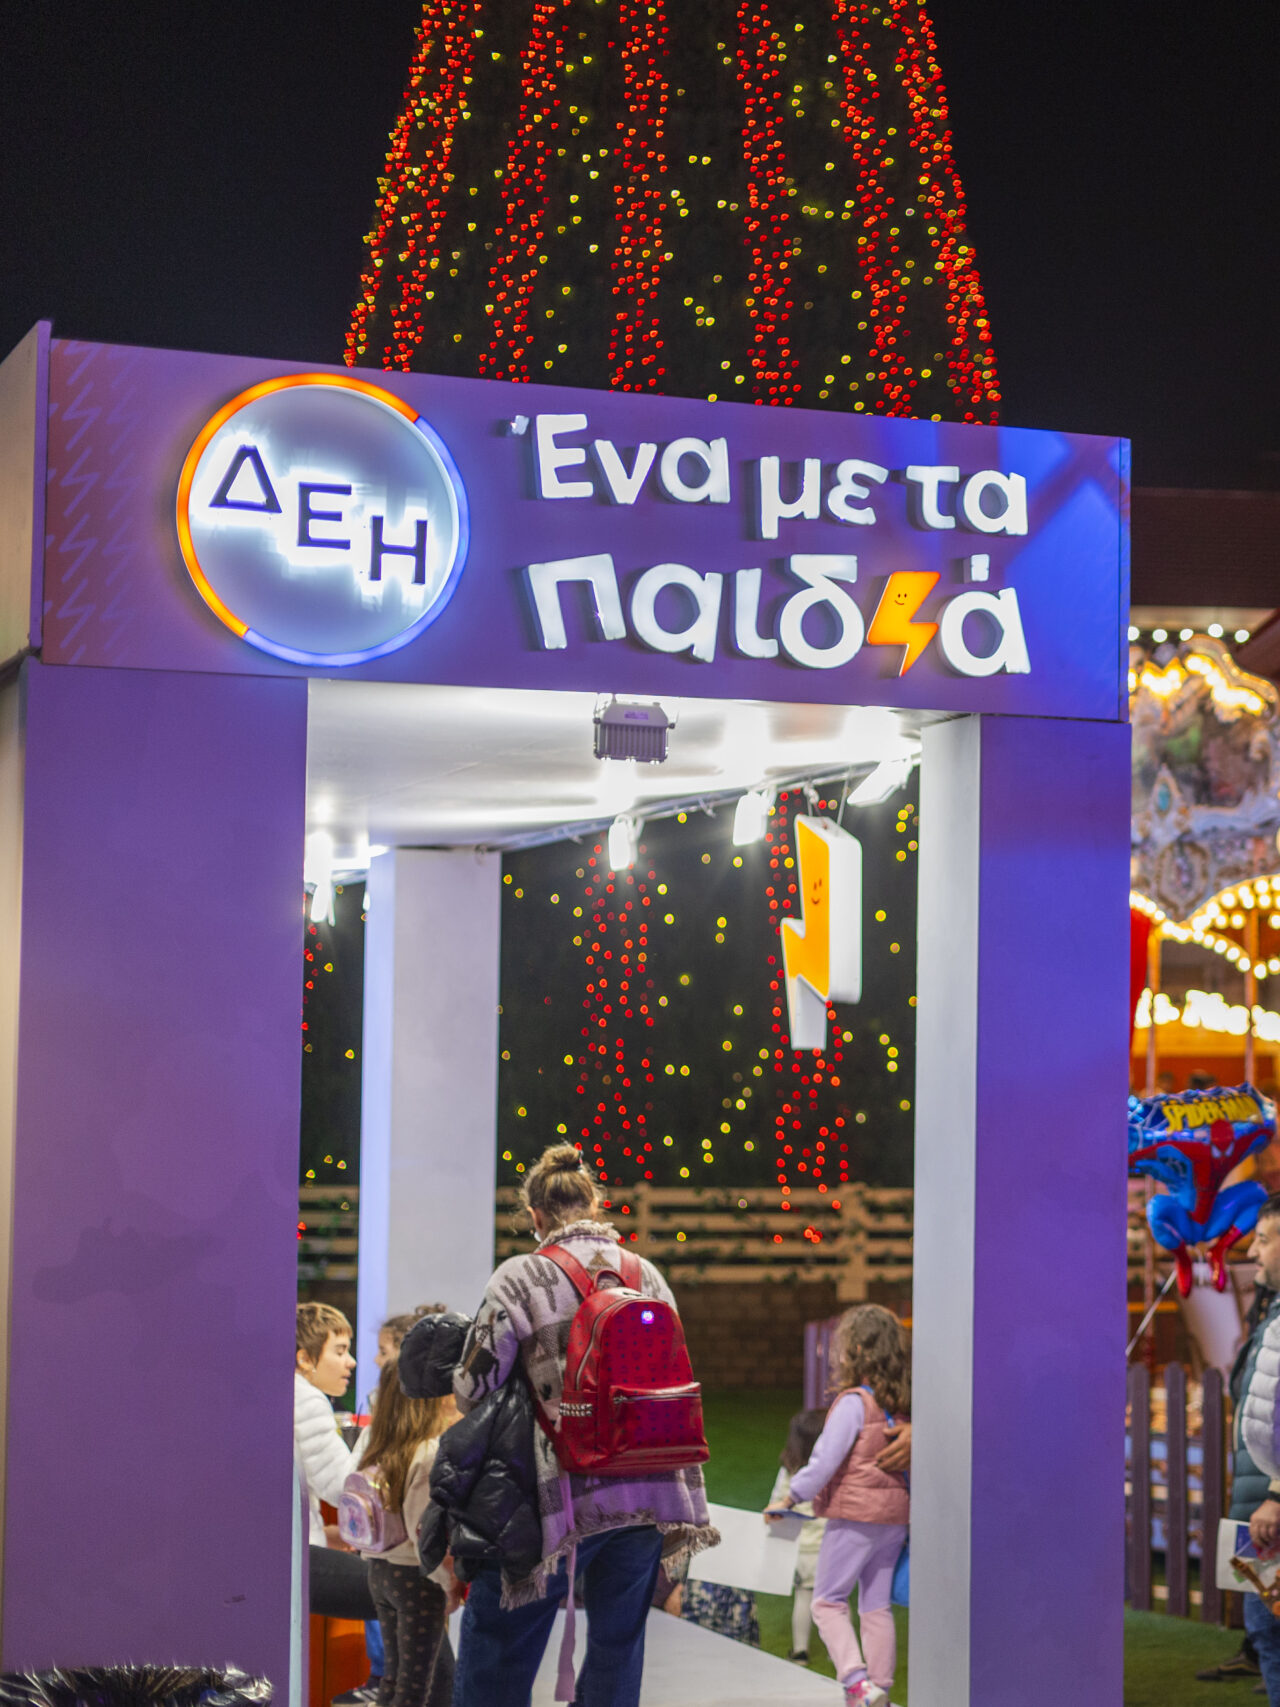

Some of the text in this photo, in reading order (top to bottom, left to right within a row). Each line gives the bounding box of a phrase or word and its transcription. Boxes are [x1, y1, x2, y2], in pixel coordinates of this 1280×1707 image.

[208, 444, 428, 585] ΔΕΗ
[760, 456, 889, 539] με
[906, 465, 1028, 535] τα
